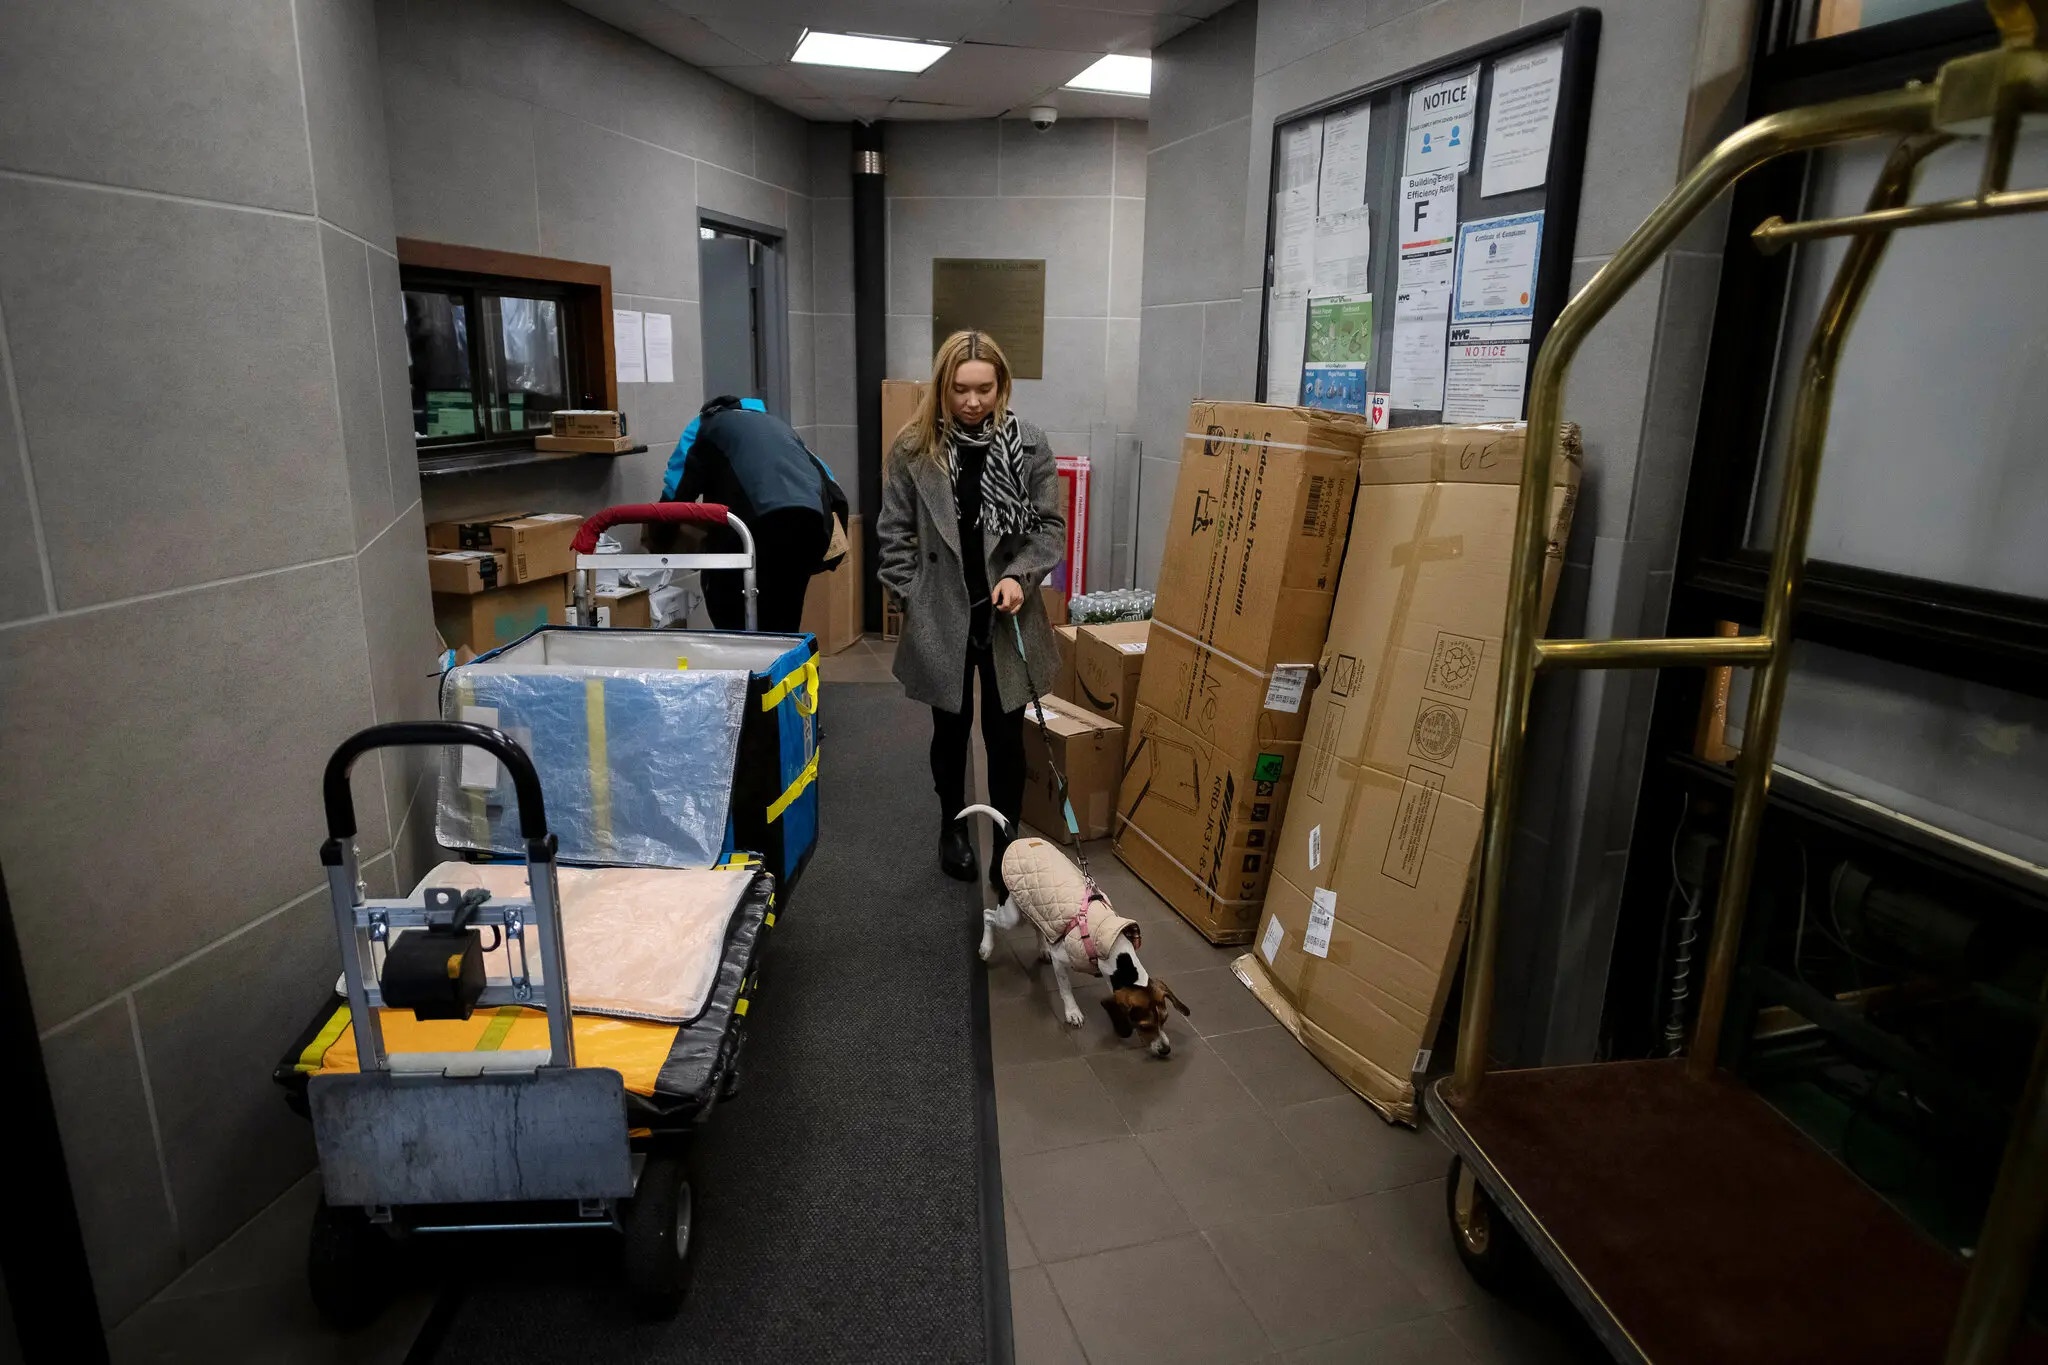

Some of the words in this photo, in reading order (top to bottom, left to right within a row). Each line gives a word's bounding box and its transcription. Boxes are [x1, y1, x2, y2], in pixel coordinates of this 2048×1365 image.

[1423, 85, 1467, 111] NOTICE
[1409, 176, 1437, 188] Building
[1407, 187, 1438, 200] Efficiency
[1414, 200, 1430, 232] F
[1451, 328, 1470, 341] NYC
[1465, 346, 1507, 357] NOTICE
[1371, 396, 1384, 405] AED
[1257, 431, 1272, 485] Under
[1248, 488, 1263, 533] Desk
[1234, 537, 1254, 617] Treadmill
